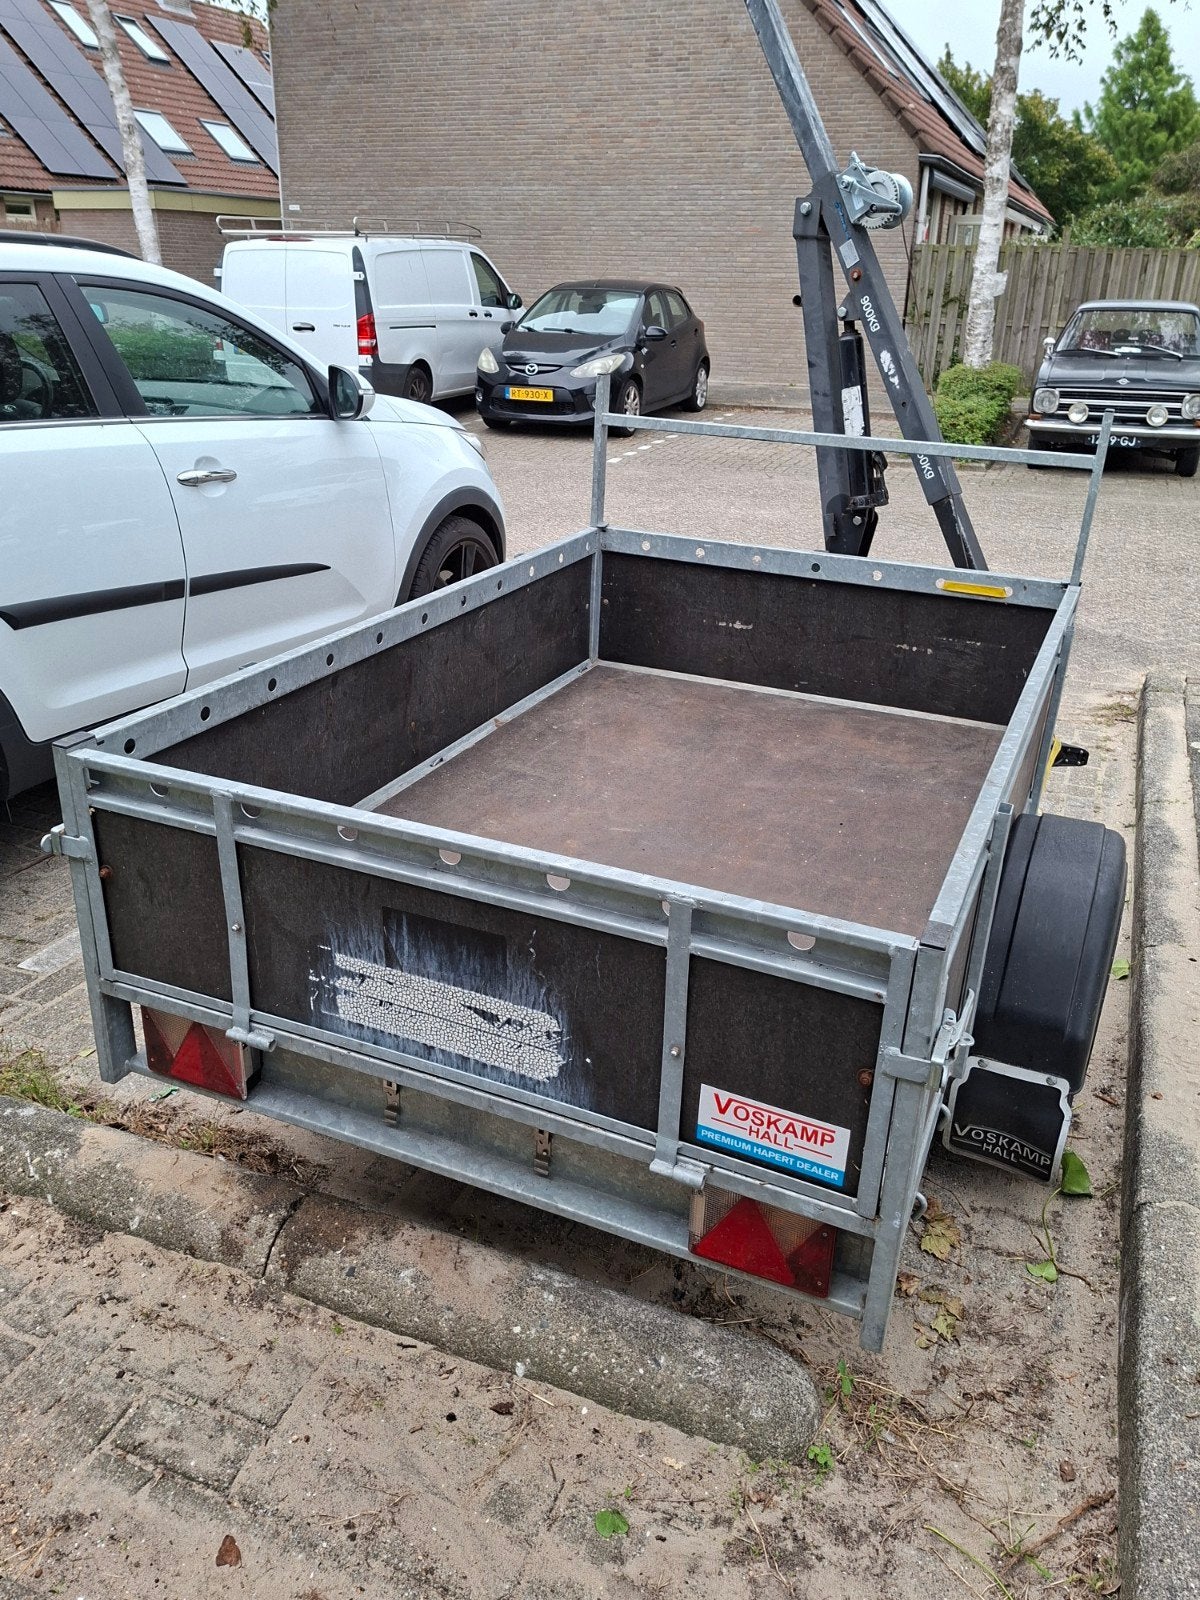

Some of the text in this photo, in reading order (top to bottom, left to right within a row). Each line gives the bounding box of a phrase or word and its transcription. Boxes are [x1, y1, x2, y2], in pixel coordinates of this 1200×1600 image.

[860, 295, 881, 333] 900Kg
[511, 389, 549, 400] RT-930-X
[713, 1092, 836, 1147] VOSKAMP
[748, 1125, 794, 1151] HALL
[701, 1129, 839, 1181] PREMIUM HAPERT DEALER
[954, 1123, 1052, 1166] VOSKAMP
[982, 1142, 1018, 1163] HALL
